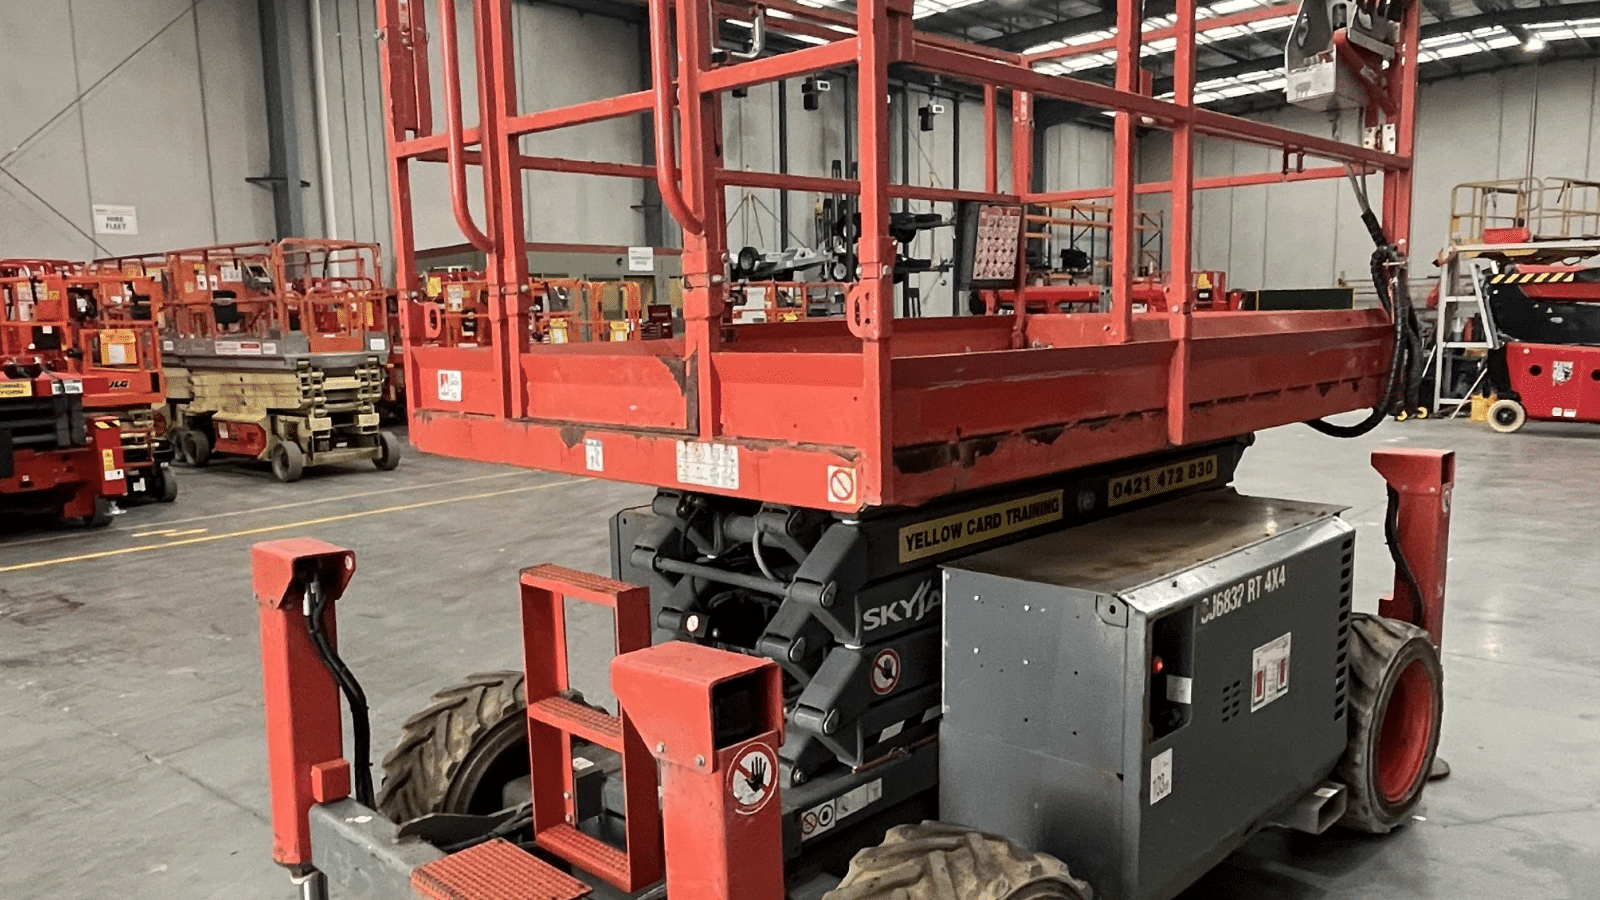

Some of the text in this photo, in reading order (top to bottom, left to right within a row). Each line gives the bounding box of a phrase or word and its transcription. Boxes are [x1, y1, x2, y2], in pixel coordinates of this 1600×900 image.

[105, 222, 127, 230] FLEET
[109, 380, 129, 388] JLG
[1113, 459, 1213, 499] 0421 472 830
[905, 497, 1059, 551] YELLOW CARD TRAINING
[1247, 575, 1263, 603] RT
[1264, 564, 1286, 593] 4X4
